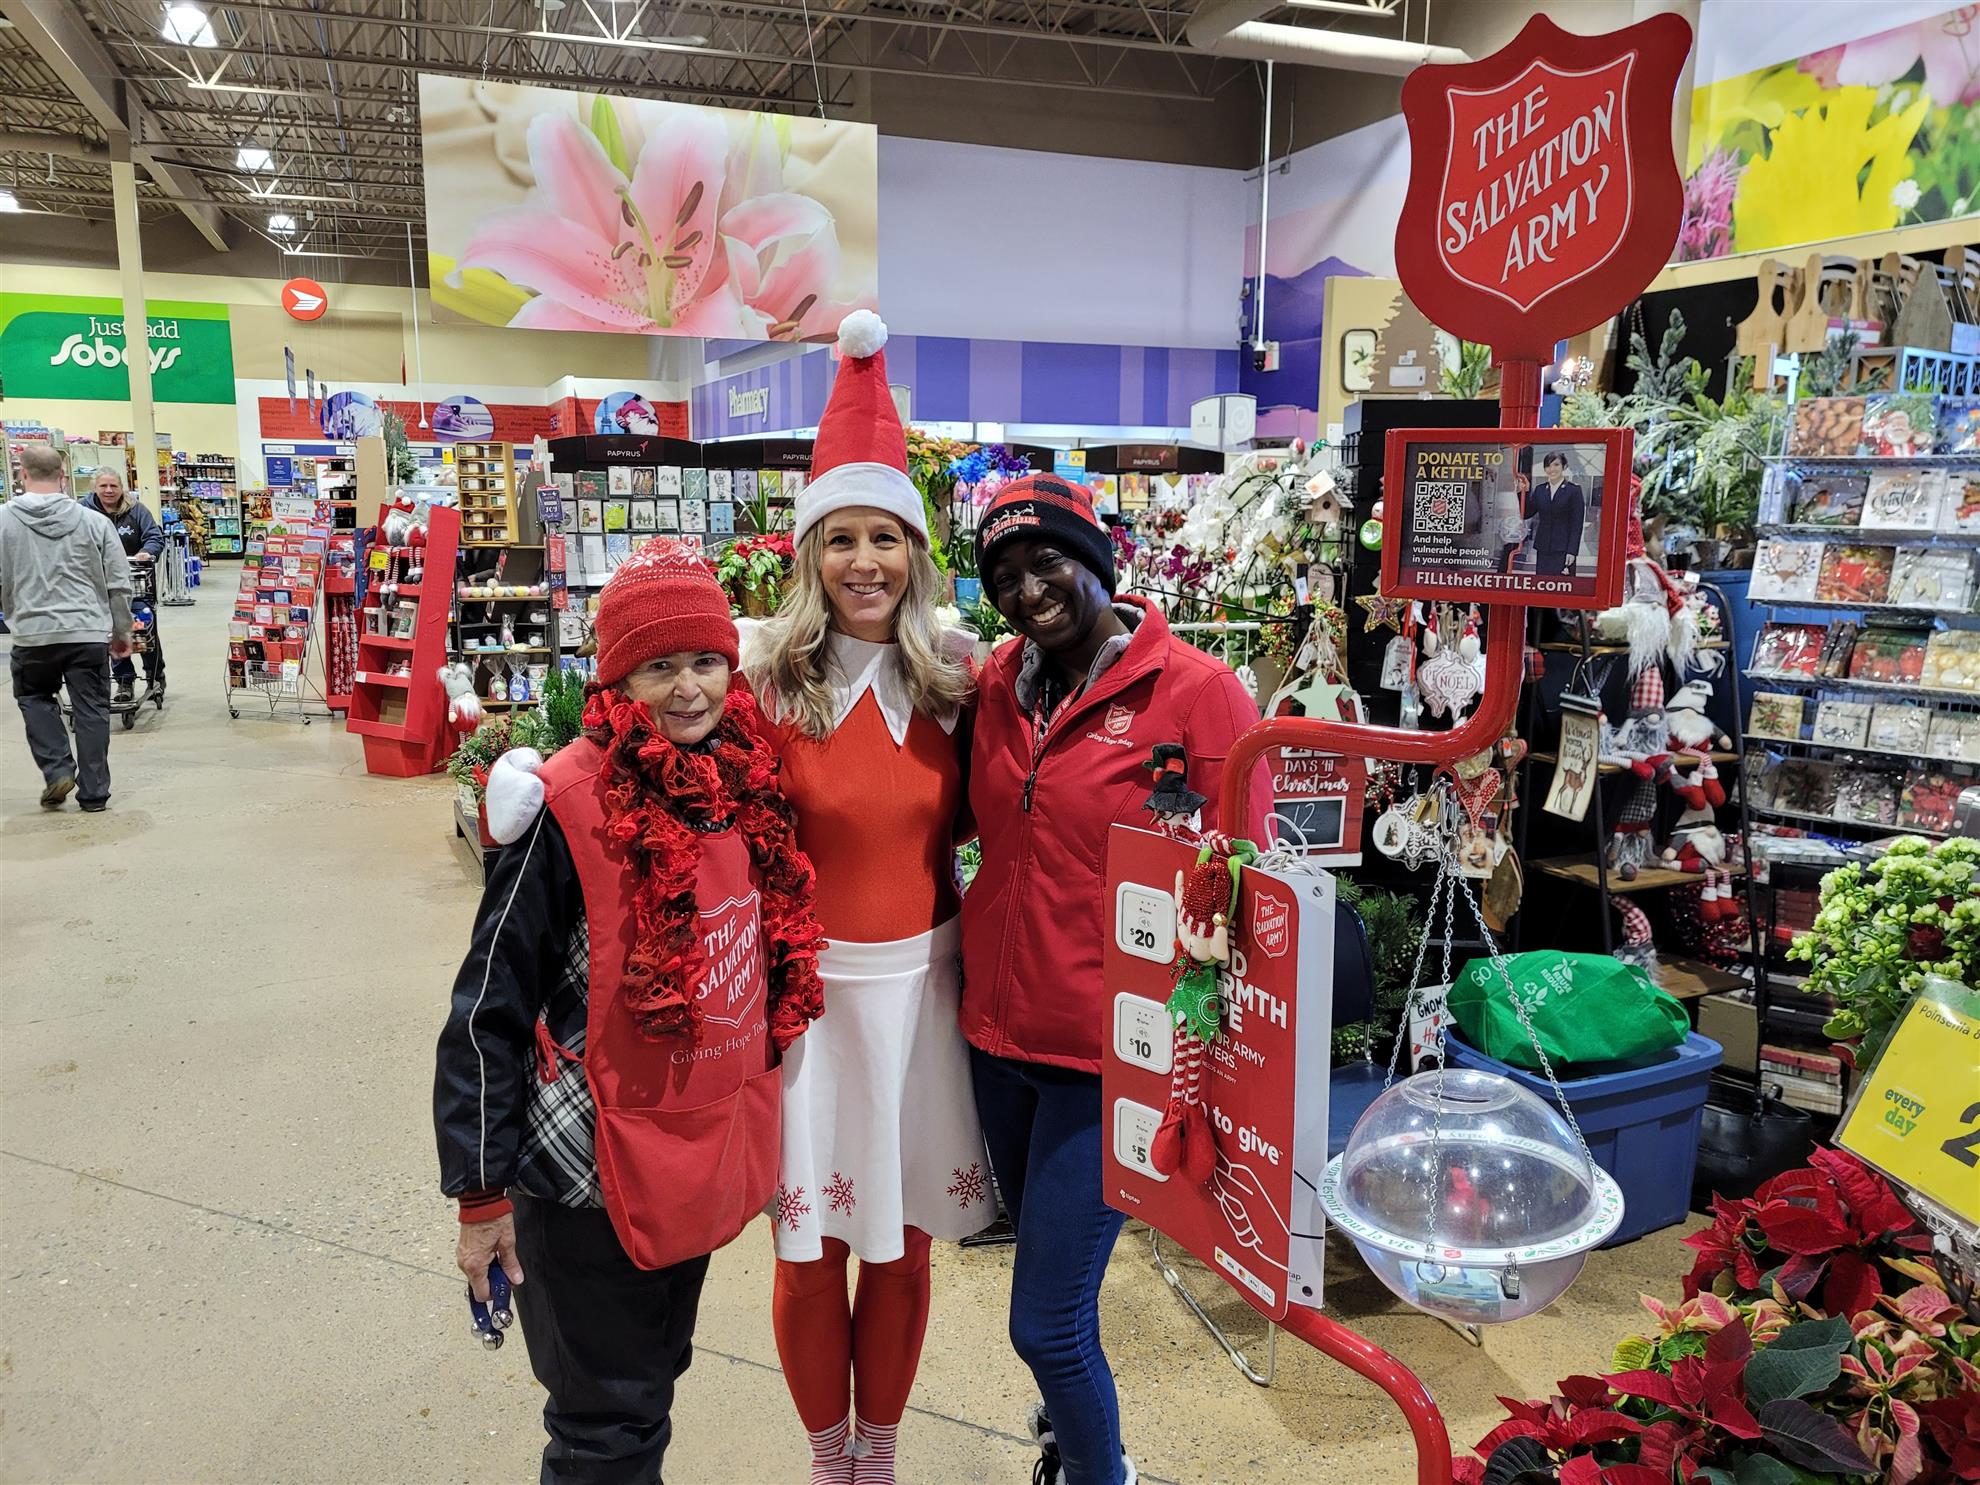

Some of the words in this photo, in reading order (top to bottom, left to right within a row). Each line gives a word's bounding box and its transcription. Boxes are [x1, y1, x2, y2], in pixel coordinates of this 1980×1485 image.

[1473, 84, 1549, 172] THE
[1445, 90, 1615, 254] SALVATION
[1500, 165, 1610, 284] ARMY
[50, 333, 182, 375] Sobys
[728, 385, 769, 423] Pharmacy
[607, 450, 641, 458] PAPYRUS
[1417, 452, 1479, 465] DONATE
[1483, 453, 1504, 466] TO
[1416, 467, 1426, 478] A
[1430, 466, 1484, 480] KETTLE
[1004, 525, 1019, 534] RIVER
[1413, 535, 1430, 544] And
[1432, 535, 1452, 545] help
[1412, 555, 1420, 563] in
[1421, 558, 1442, 566] your
[1443, 557, 1494, 568] community
[1413, 545, 1457, 554] vulnerable
[1459, 548, 1489, 557] people
[1416, 571, 1573, 593] FILLtheKETTLE.com
[1439, 675, 1474, 690] NOEL
[1285, 760, 1317, 773] DAYS
[1273, 773, 1351, 794] Christmas
[1291, 803, 1316, 832] 12
[1261, 904, 1274, 918] THE
[1256, 913, 1285, 935] SALVATION
[704, 914, 737, 957] THE
[1130, 928, 1155, 949] $20
[1265, 929, 1284, 947] ARMY
[696, 913, 757, 1000] SALVATION
[727, 946, 757, 1010] ARMY
[1470, 966, 1492, 987] GO
[1541, 968, 1565, 995] REDUCE
[1552, 971, 1573, 993] REUSE
[1418, 996, 1442, 1017] GNOM
[671, 1043, 722, 1065] Giving
[725, 1025, 751, 1052] Hope
[1130, 1038, 1151, 1058] $10
[1232, 1041, 1266, 1068] ARMY
[1885, 1089, 1926, 1119] every
[1213, 1106, 1233, 1134] to
[1884, 1107, 1917, 1137] day
[1132, 1145, 1146, 1163] $5
[1319, 1177, 1342, 1212] d'espoir
[1334, 1210, 1367, 1235] pour
[1369, 1231, 1383, 1241] la
[1388, 1240, 1414, 1251] vie
